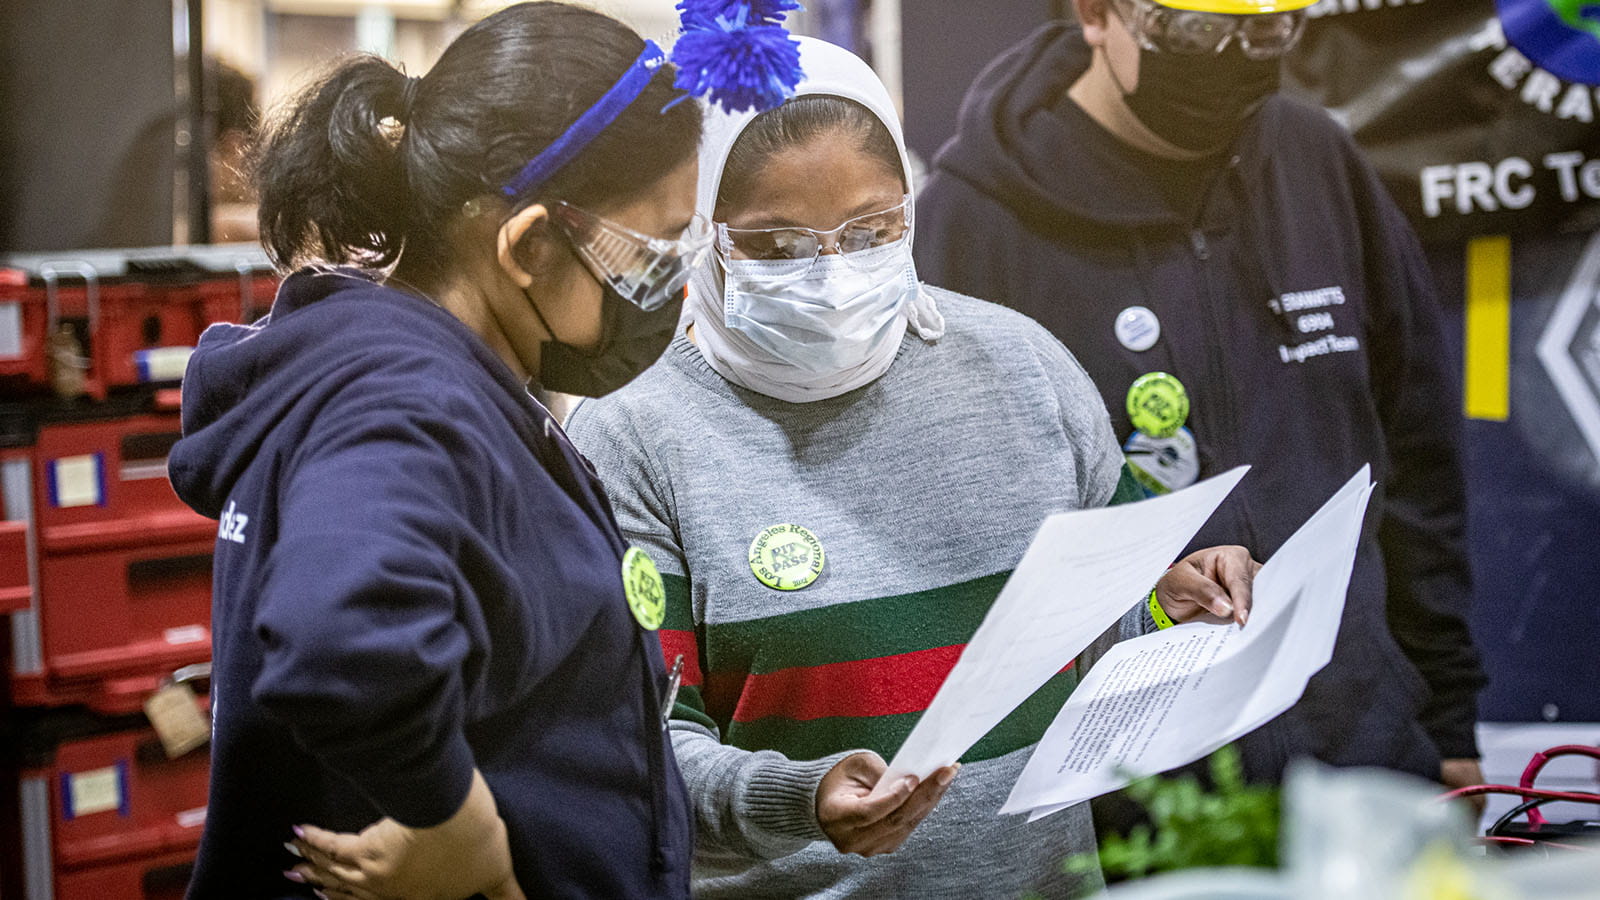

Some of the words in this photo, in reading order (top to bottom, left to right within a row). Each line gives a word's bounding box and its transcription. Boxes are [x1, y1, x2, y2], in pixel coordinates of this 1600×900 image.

[1420, 157, 1536, 217] FRC
[750, 525, 786, 565] Angeles
[771, 542, 796, 558] PIT
[789, 524, 822, 576] Regional
[758, 566, 784, 588] Los
[771, 554, 809, 573] PASS
